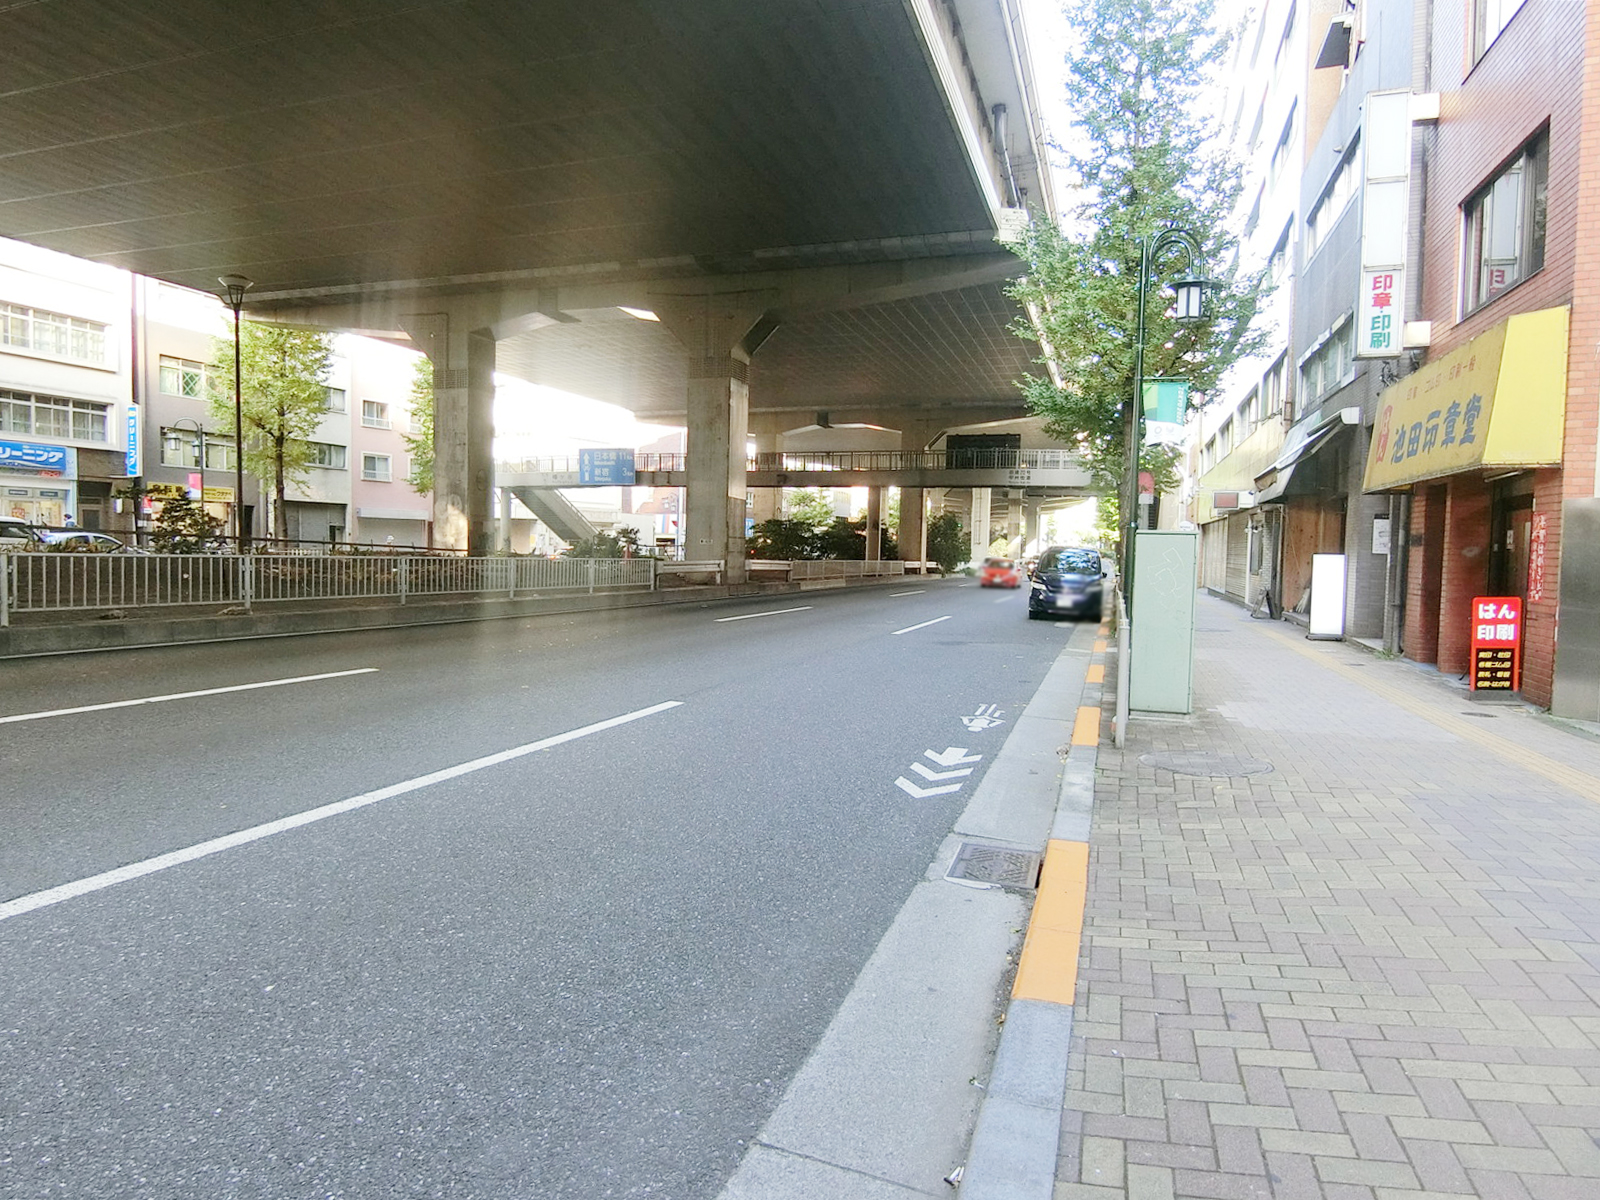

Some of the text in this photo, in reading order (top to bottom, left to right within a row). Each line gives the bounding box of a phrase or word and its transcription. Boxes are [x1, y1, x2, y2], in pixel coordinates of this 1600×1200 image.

[1390, 392, 1482, 466] 池田印章堂
[128, 418, 137, 465] クリーニング
[593, 451, 617, 460] 日本橋
[594, 467, 610, 477] 新宿
[1478, 603, 1515, 619] はん
[1477, 624, 1515, 640] 印刷
